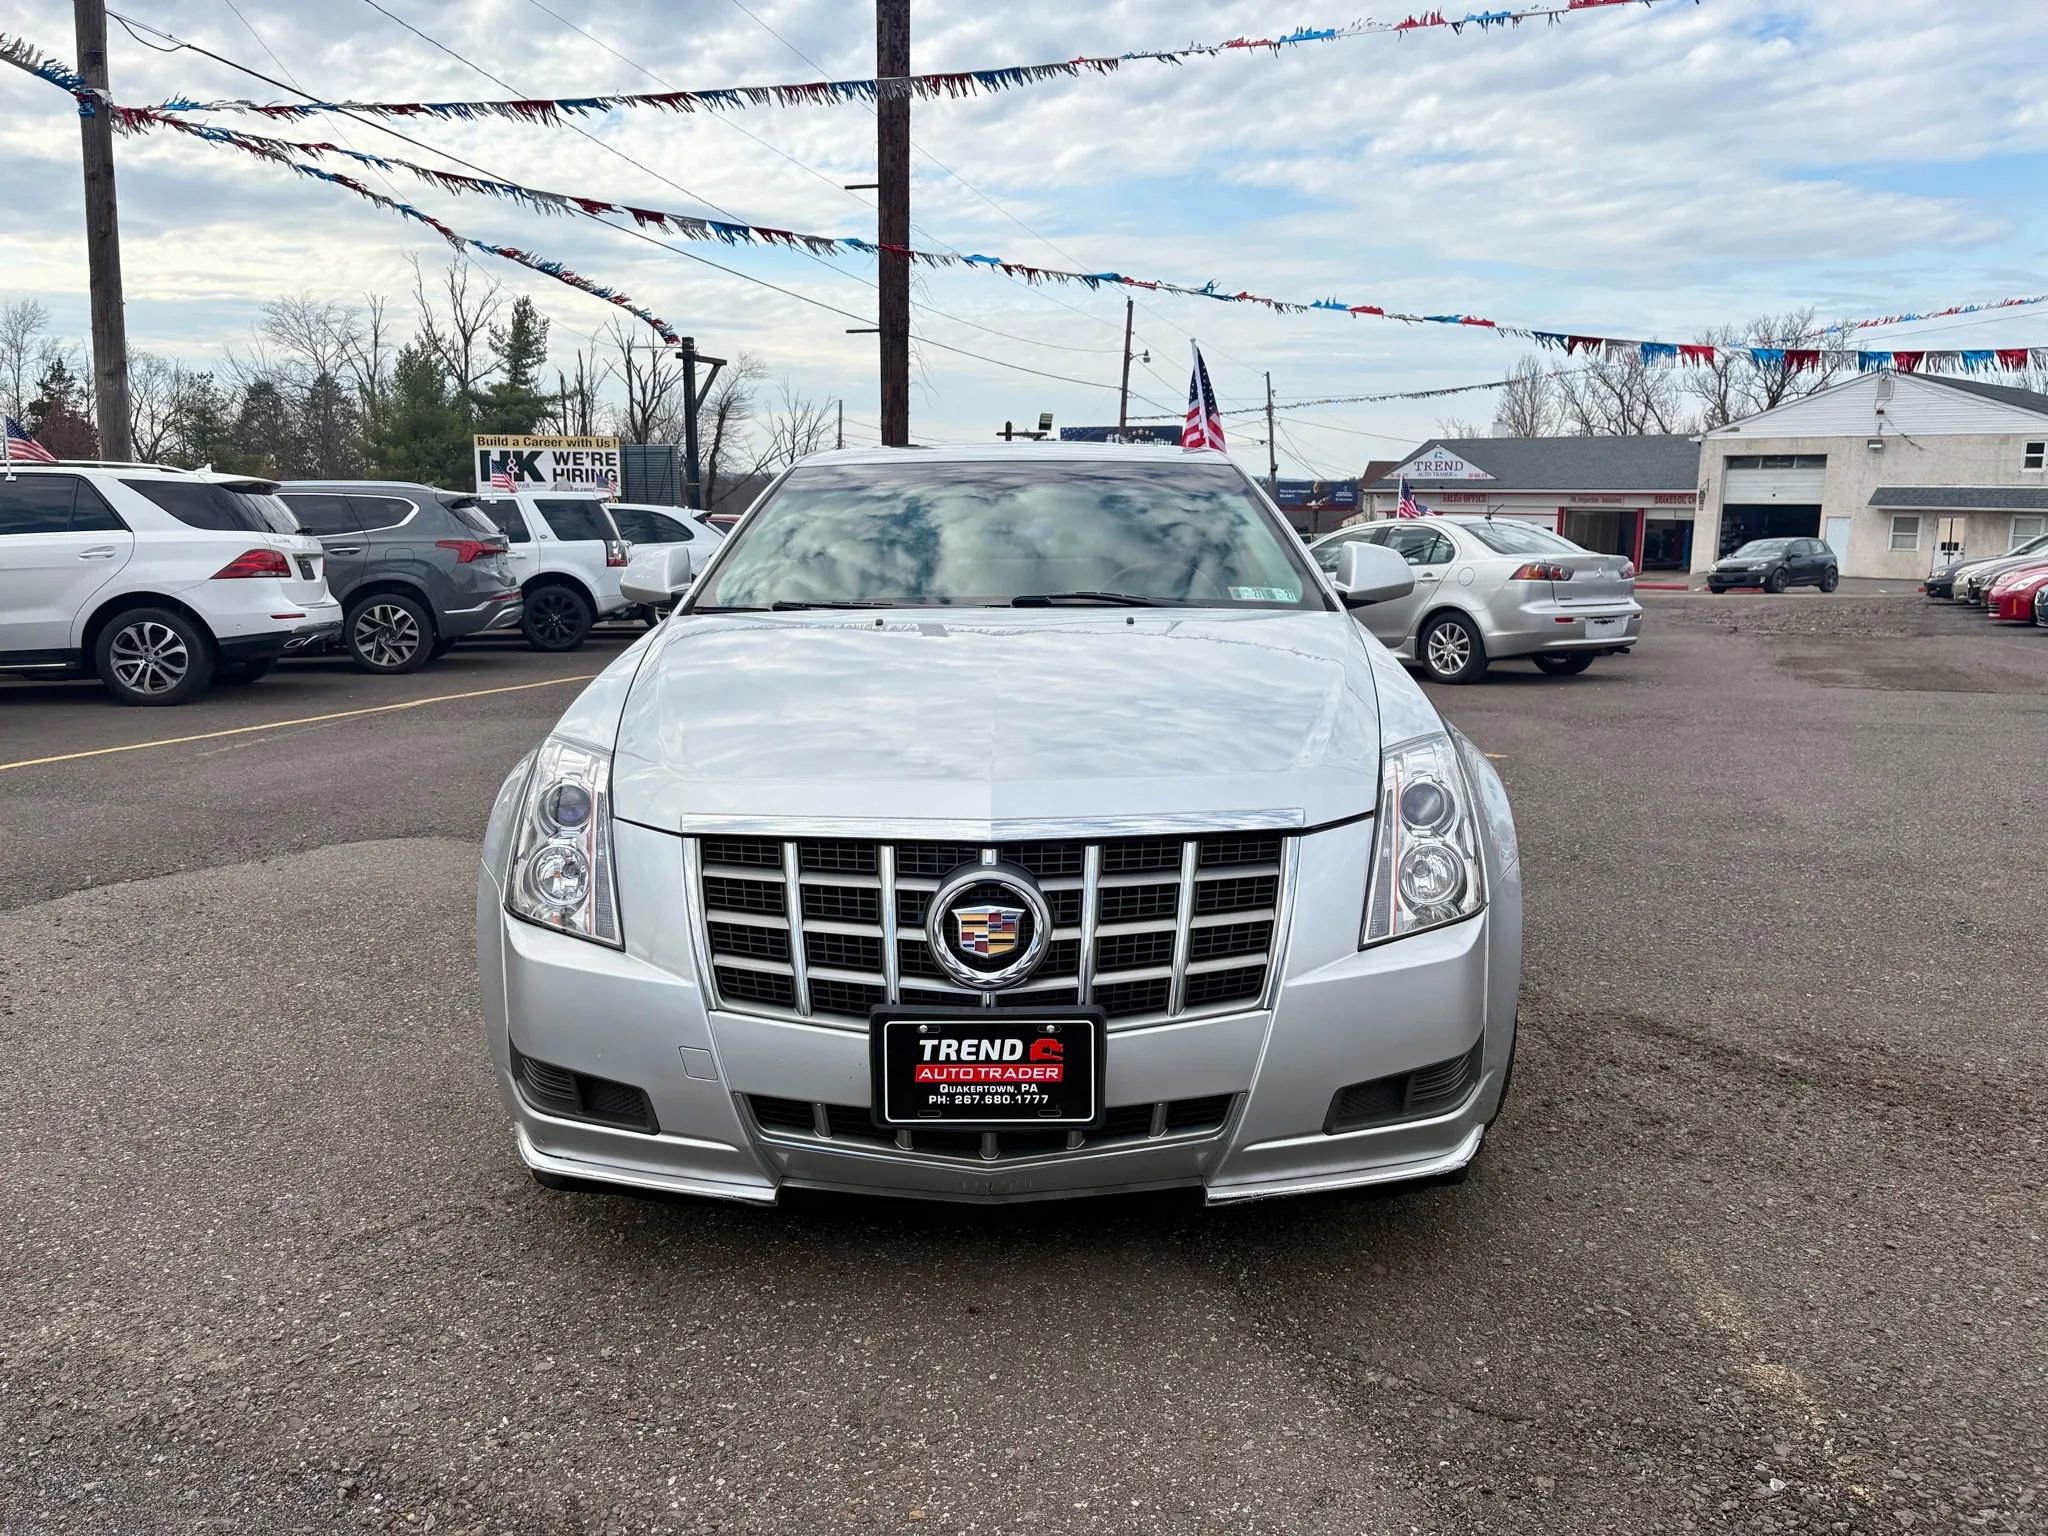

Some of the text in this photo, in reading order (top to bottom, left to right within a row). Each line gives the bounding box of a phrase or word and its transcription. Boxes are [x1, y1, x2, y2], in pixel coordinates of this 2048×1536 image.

[477, 436, 508, 446] Build
[512, 439, 519, 447] a
[523, 436, 562, 447] Career
[566, 438, 592, 448] with
[552, 451, 617, 466] WE'RE
[479, 450, 546, 482] H&K
[1414, 461, 1464, 472] TREND
[552, 468, 618, 483] HIRING
[1442, 494, 1487, 503] SALES OFFICE
[919, 1039, 1023, 1061] TREND
[918, 1067, 1059, 1080] AUTO TRADER
[1021, 1083, 1038, 1093] PA
[928, 1094, 1049, 1104] PH: 267.680.1777
